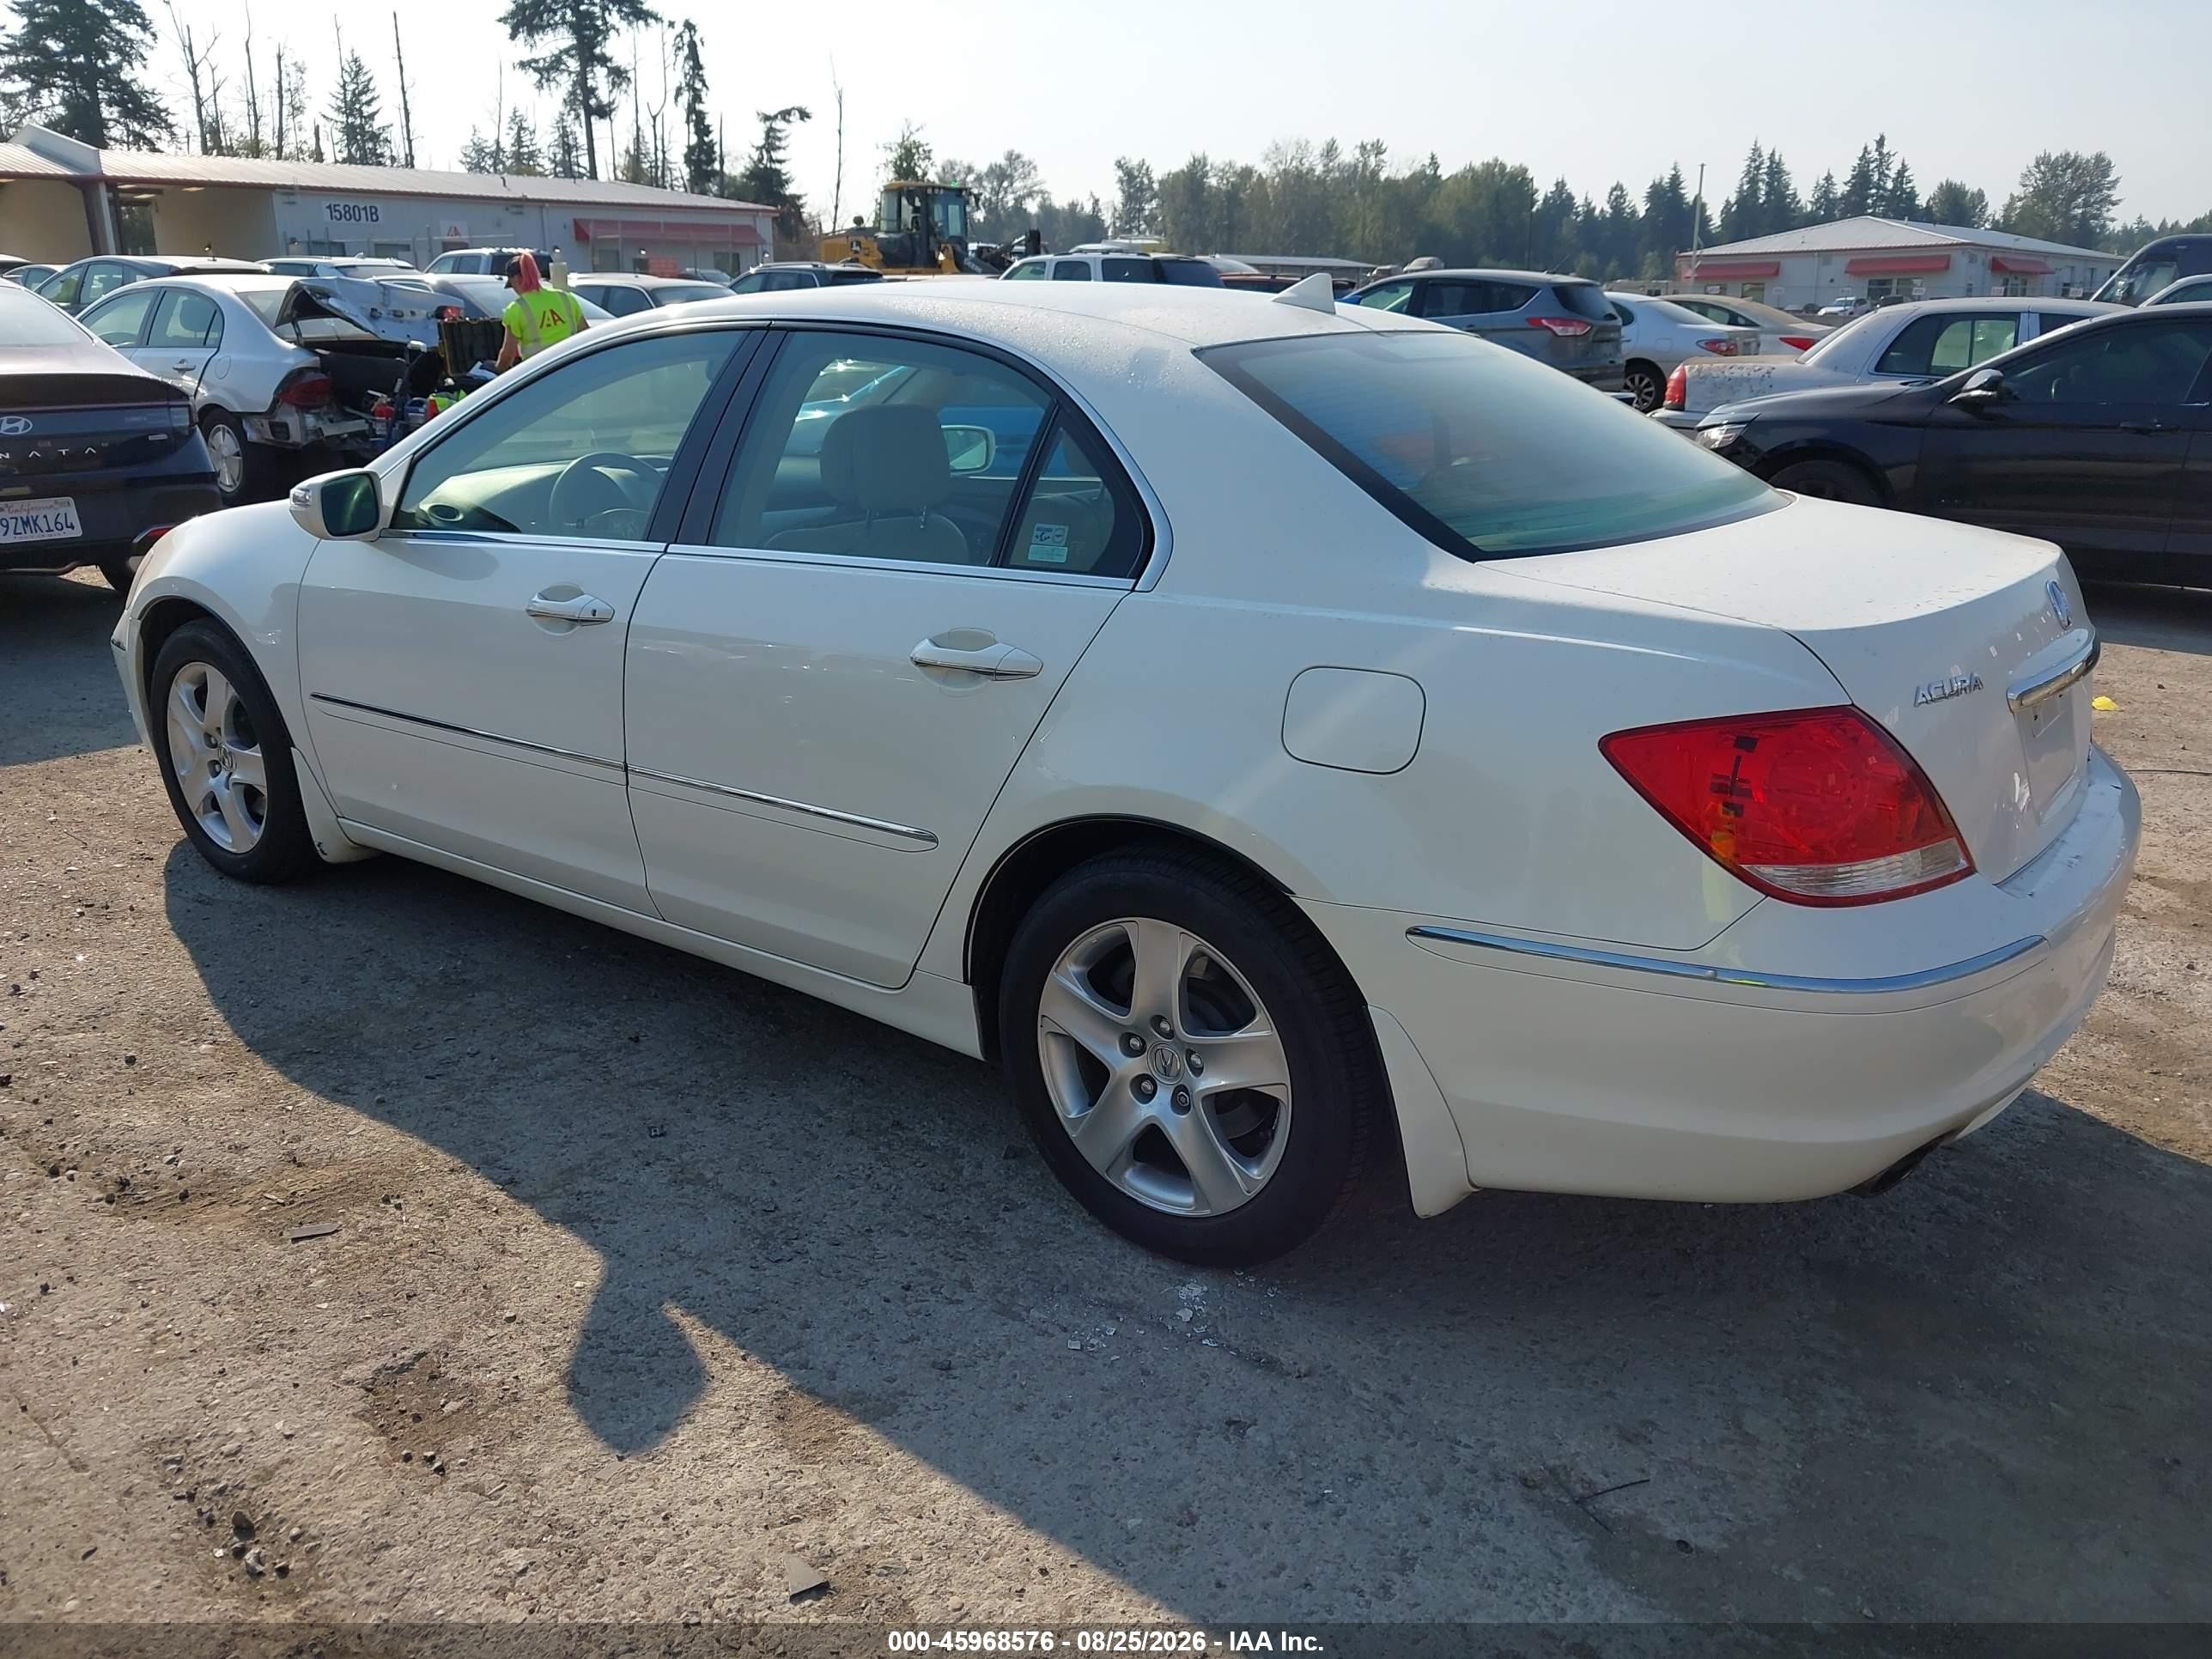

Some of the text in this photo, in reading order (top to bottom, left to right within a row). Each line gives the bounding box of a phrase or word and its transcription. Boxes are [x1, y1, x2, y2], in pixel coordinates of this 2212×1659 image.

[325, 203, 380, 223] 15801B
[0, 512, 75, 537] 9ZMK164
[1913, 673, 1984, 708] ACURA
